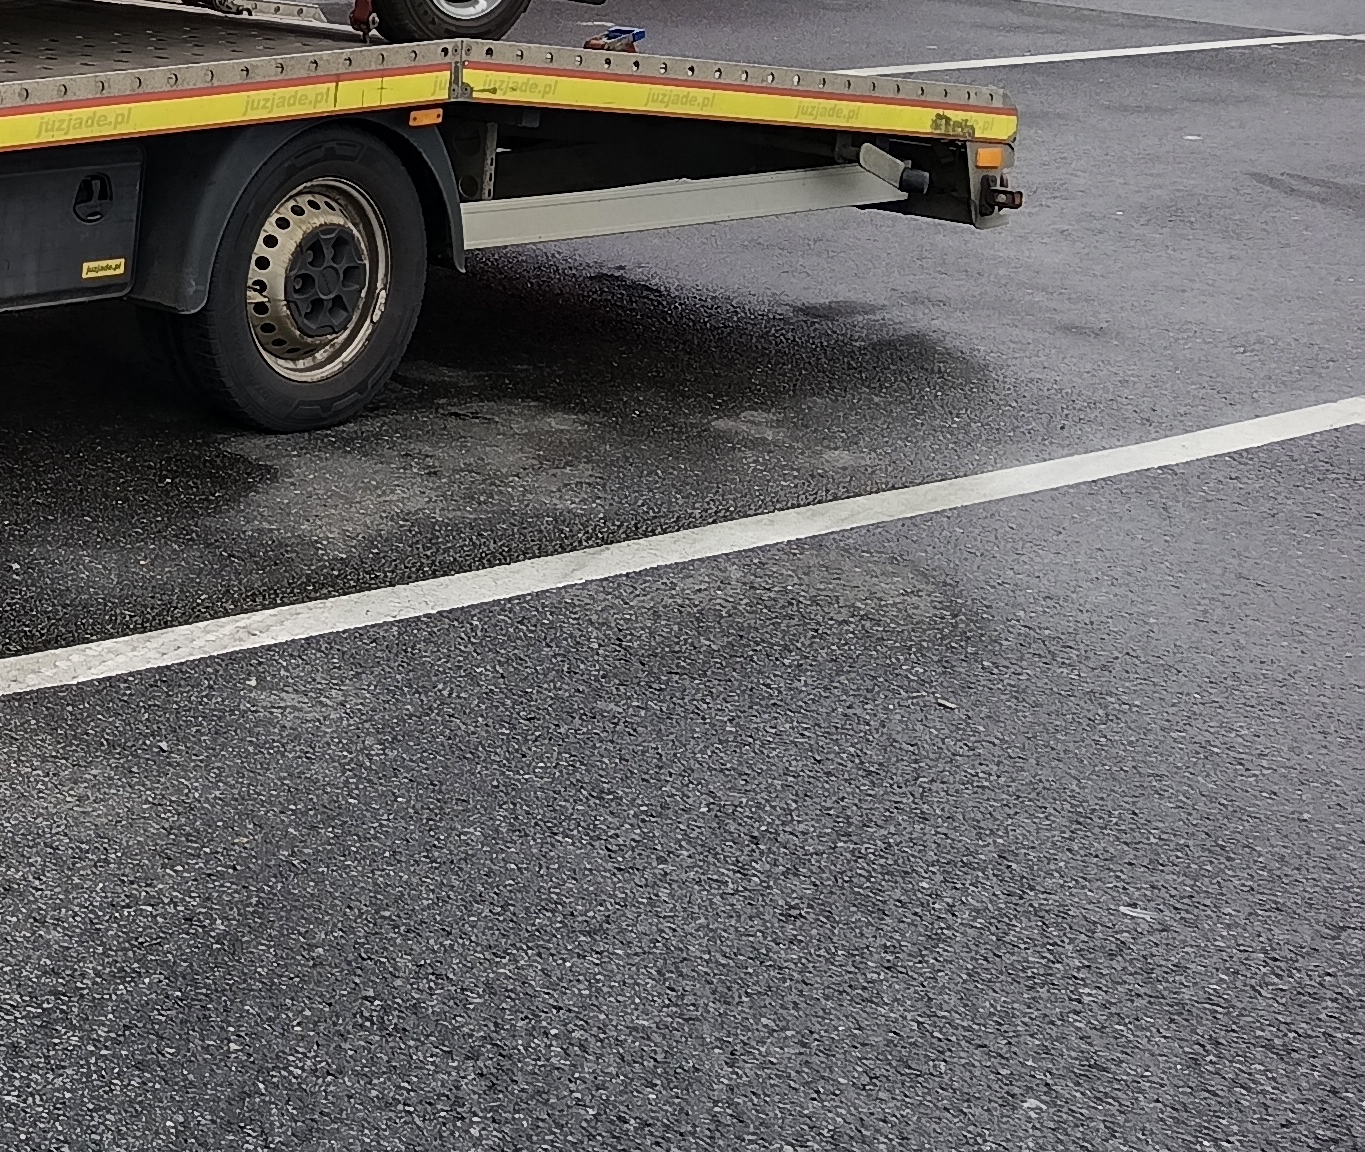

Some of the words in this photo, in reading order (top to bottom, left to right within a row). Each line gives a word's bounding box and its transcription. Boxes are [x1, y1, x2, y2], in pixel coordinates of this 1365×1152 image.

[482, 73, 558, 99] juzjade.pl
[644, 87, 716, 110] juzjade.pl
[242, 87, 330, 117] juzjade.pl
[794, 101, 861, 121] juzjade.pl
[35, 107, 132, 138] juzjade.pl
